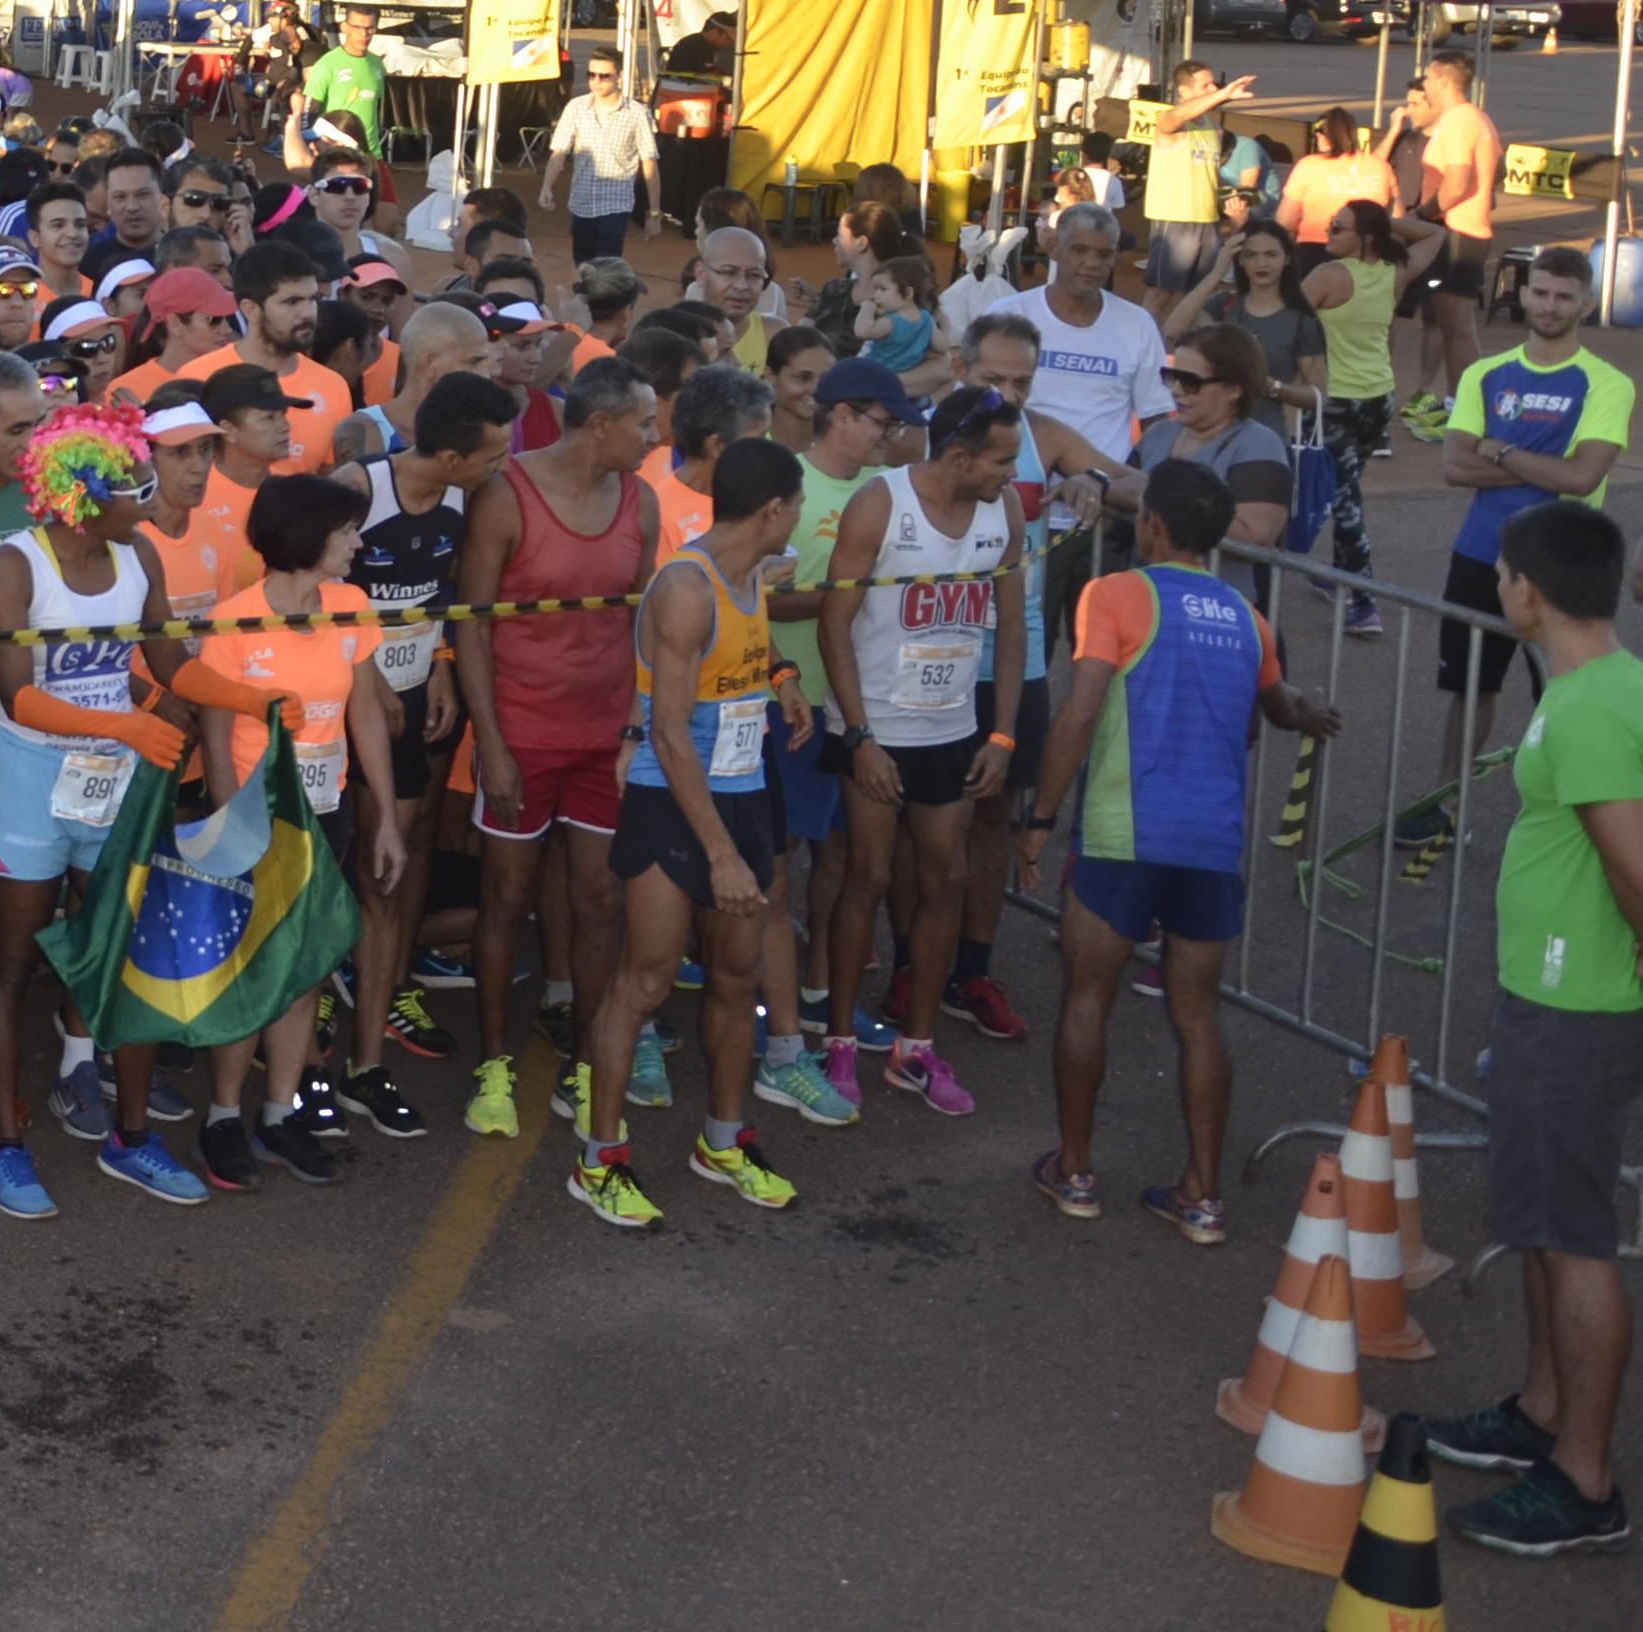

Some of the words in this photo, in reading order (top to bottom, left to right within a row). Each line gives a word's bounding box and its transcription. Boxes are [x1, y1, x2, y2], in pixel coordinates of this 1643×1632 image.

[1508, 169, 1565, 189] MTC
[1054, 353, 1114, 375] SENAI
[1522, 392, 1574, 413] SESI
[384, 642, 417, 668] 803
[920, 663, 956, 686] 532
[735, 721, 759, 748] 577
